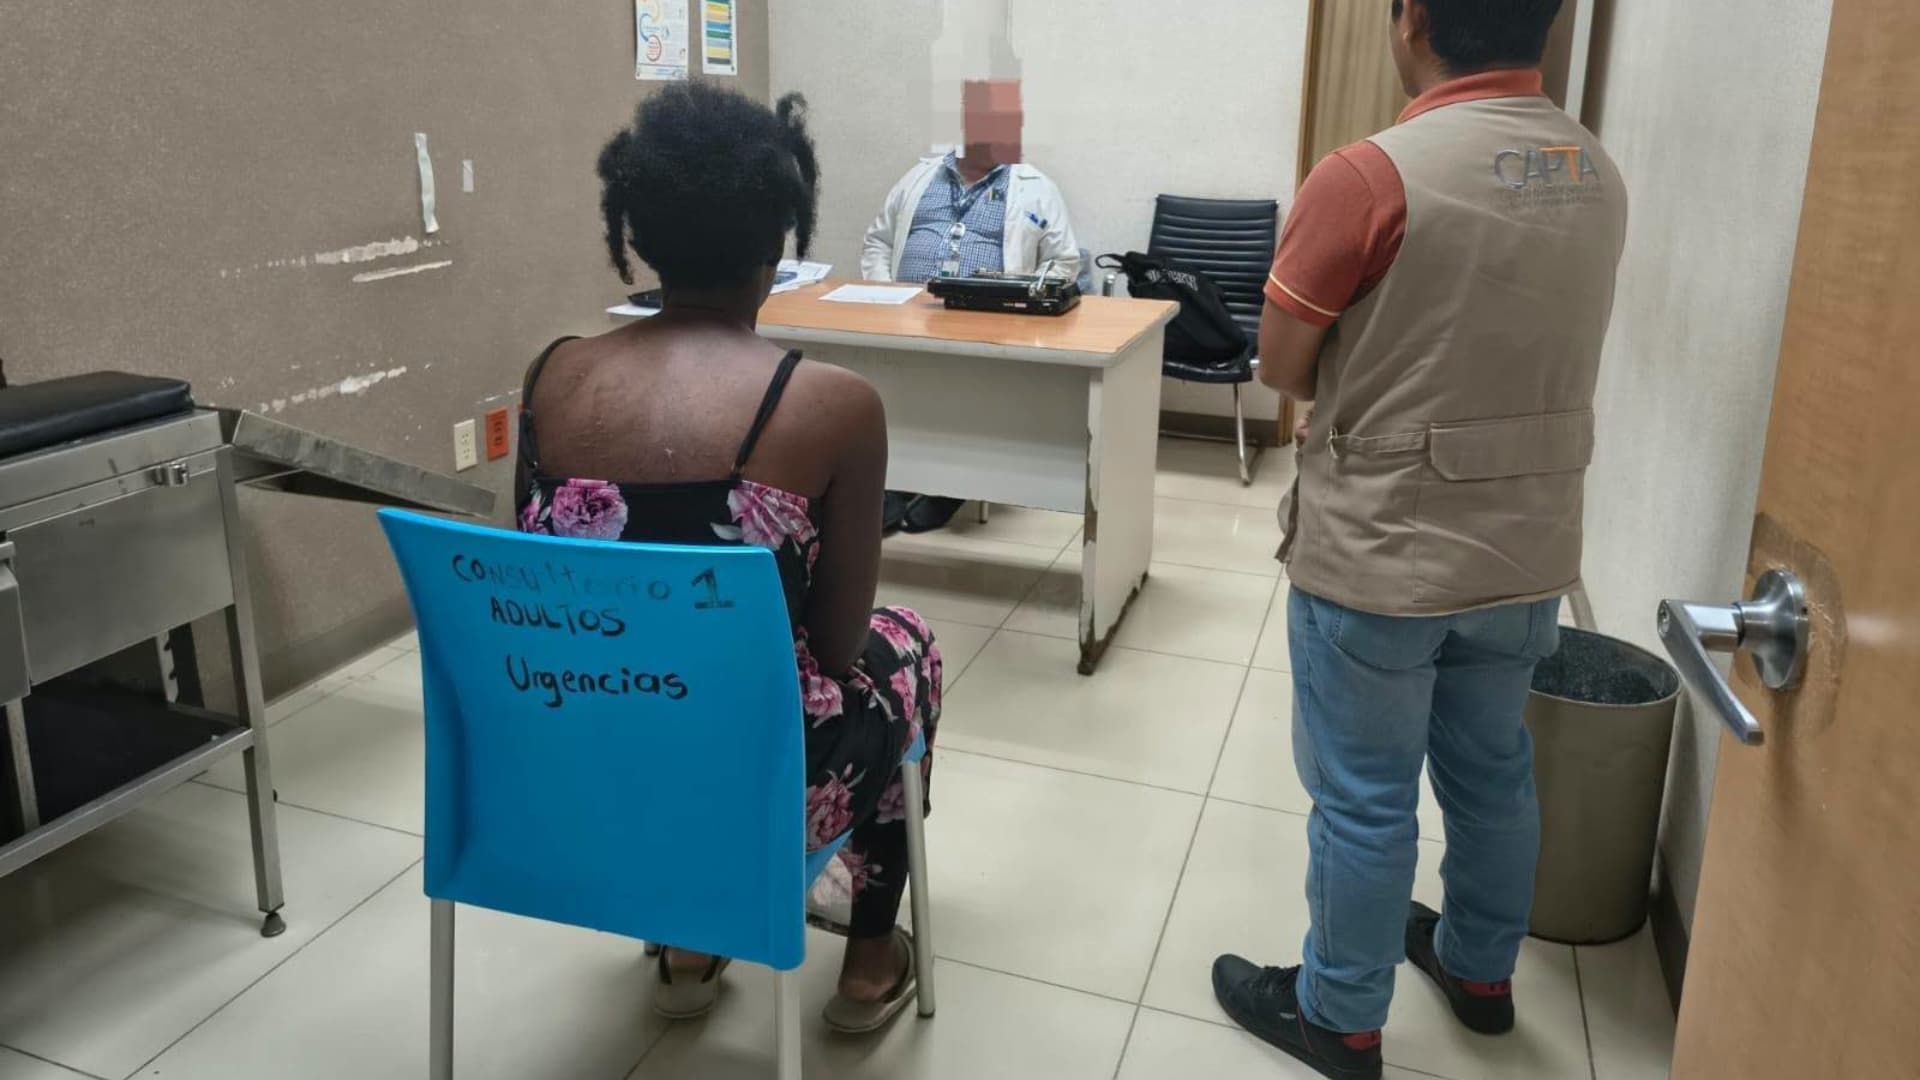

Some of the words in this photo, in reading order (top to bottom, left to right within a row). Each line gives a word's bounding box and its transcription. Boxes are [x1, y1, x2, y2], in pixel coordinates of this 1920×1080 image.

[1494, 146, 1600, 190] CAPTA
[690, 567, 735, 609] 1
[490, 596, 626, 637] ADULTOS
[505, 655, 689, 708] Urgencias
